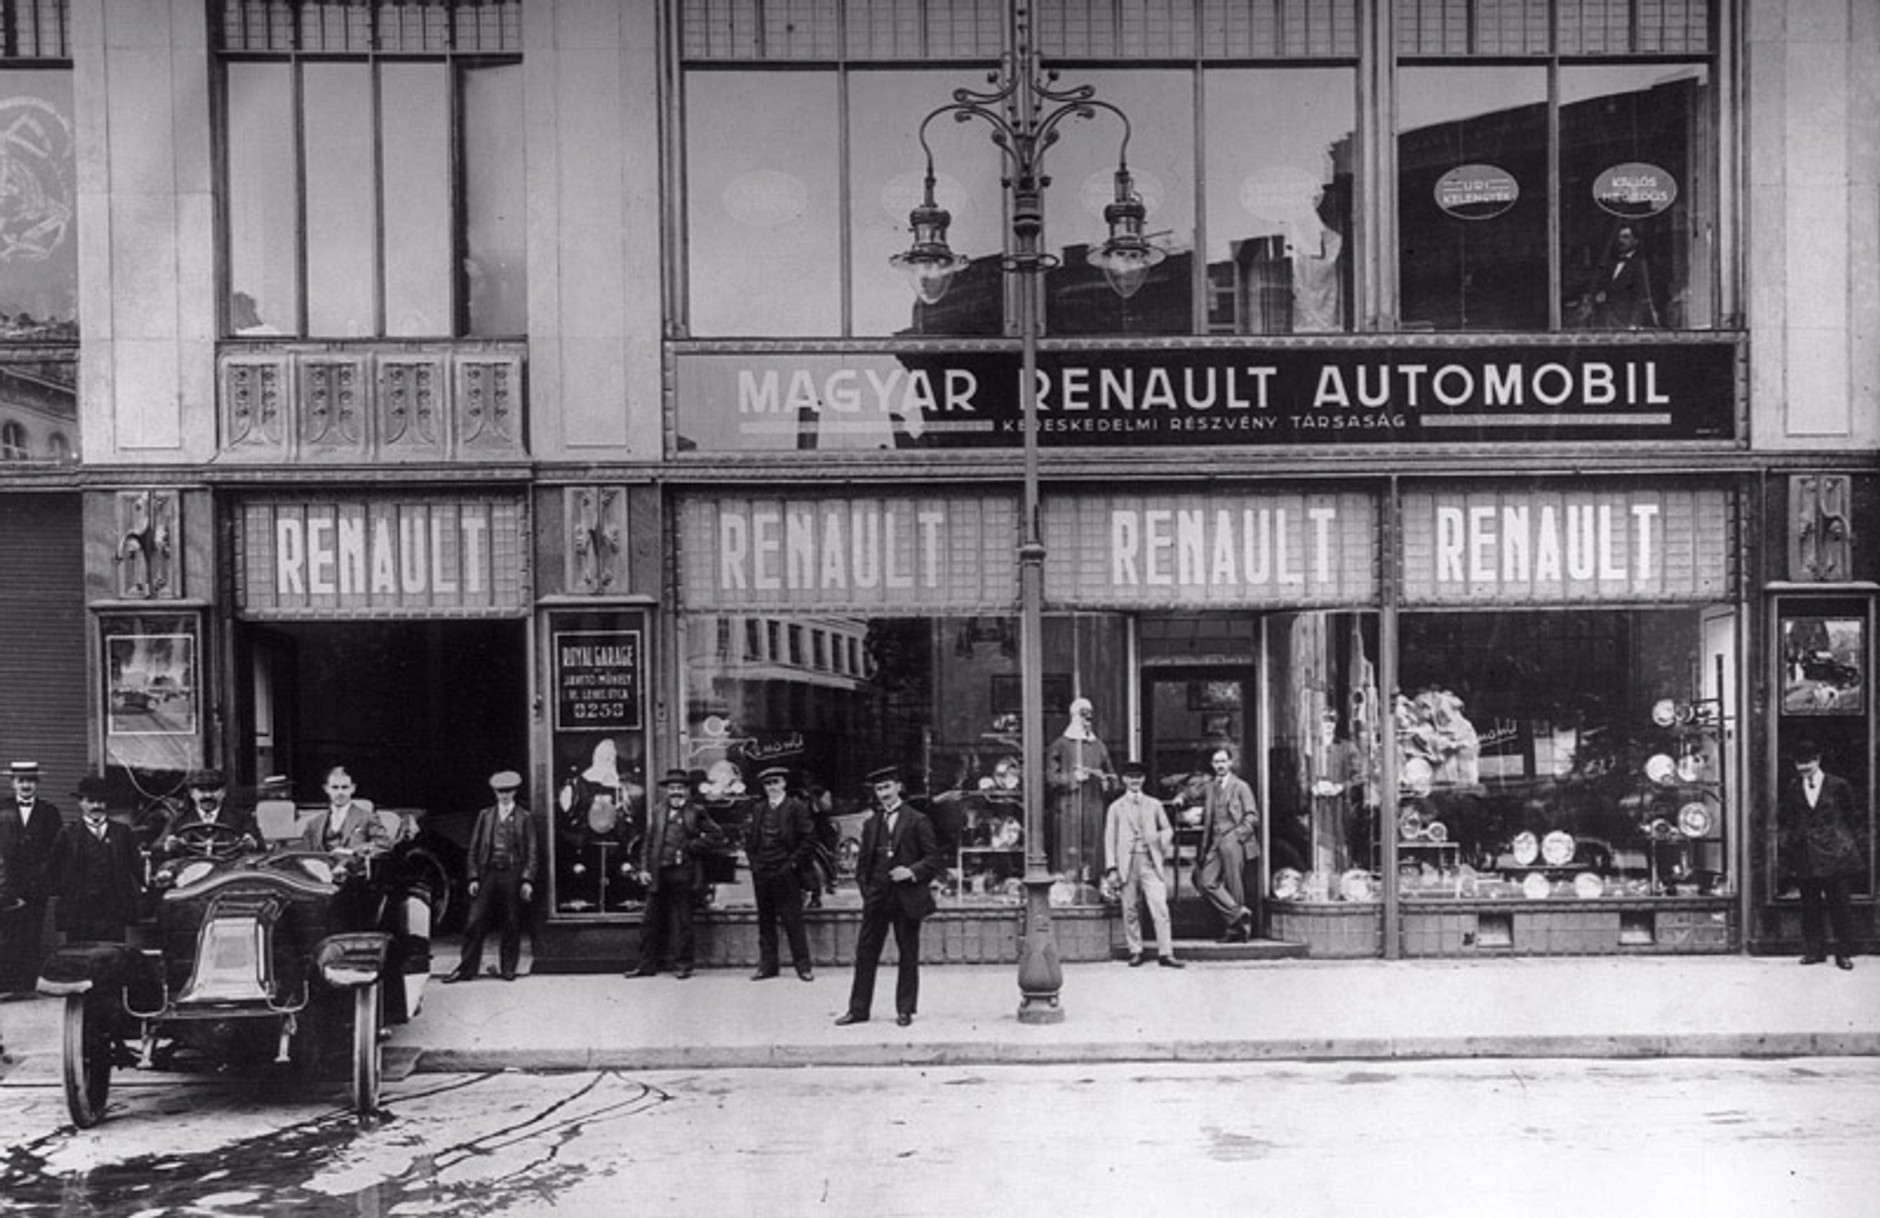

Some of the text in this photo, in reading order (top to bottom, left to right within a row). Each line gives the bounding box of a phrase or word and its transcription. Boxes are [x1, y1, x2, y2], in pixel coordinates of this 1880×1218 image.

[737, 361, 1671, 414] MAGYAR RENAULT AUTOMOBIL
[1170, 415, 1278, 432] RÉSZVÉNY
[1290, 411, 1406, 429] TÁRSASÁG
[276, 517, 486, 594] RENAULT
[720, 511, 944, 589] RENAULT
[1111, 508, 1336, 585] RENAULT
[1437, 504, 1659, 582] RENAULT
